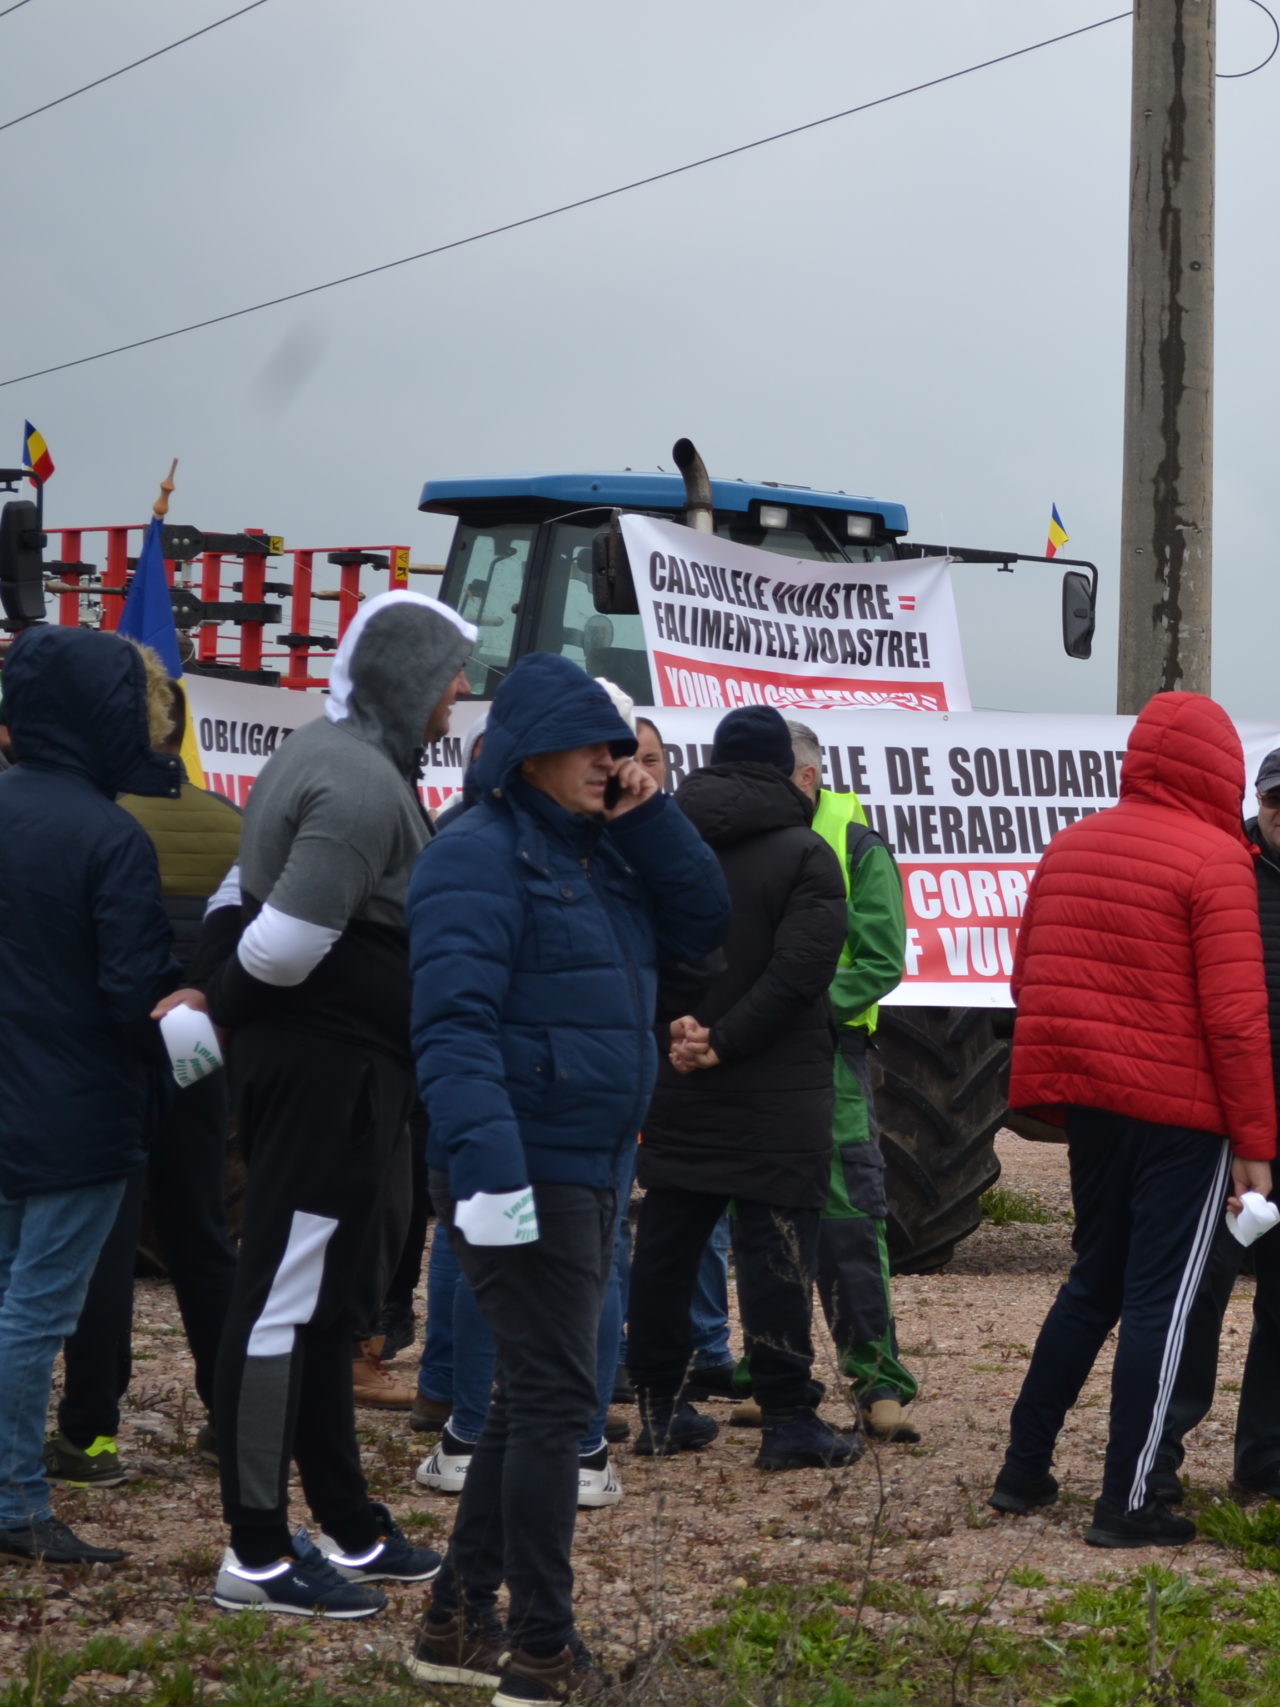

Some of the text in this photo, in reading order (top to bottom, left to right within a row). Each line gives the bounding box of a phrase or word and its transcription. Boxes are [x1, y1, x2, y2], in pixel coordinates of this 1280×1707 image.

[650, 551, 770, 611] CALCULELE
[771, 581, 894, 621] VOASTRE
[651, 600, 931, 669] FALIMENTELE NOASTRE!
[664, 665, 724, 708] YOUR
[884, 746, 935, 796] DE
